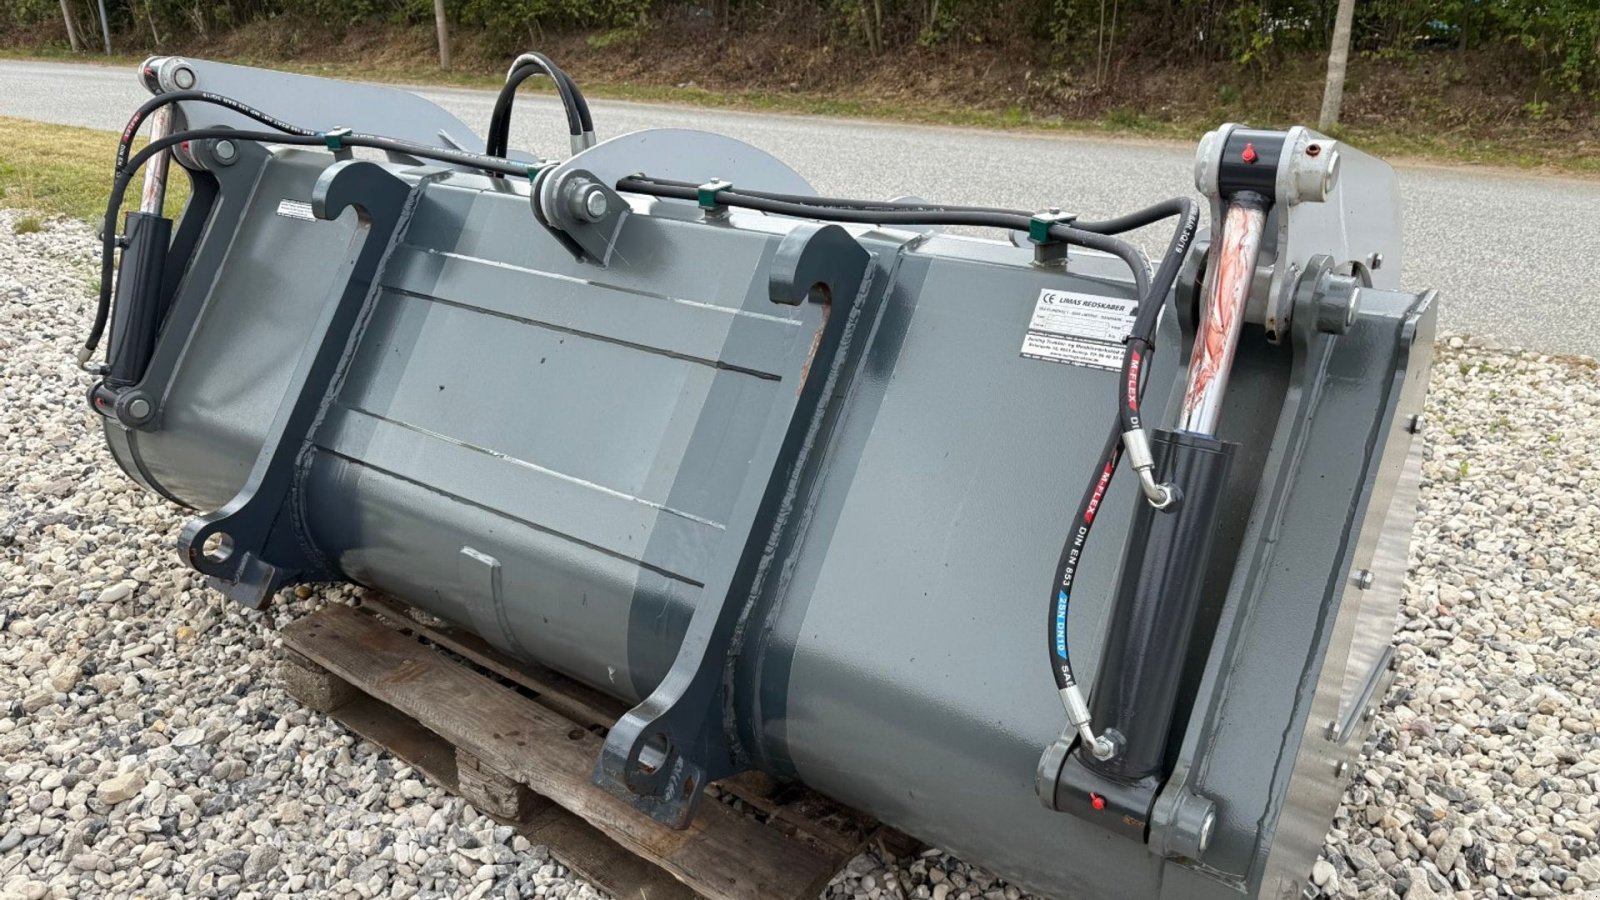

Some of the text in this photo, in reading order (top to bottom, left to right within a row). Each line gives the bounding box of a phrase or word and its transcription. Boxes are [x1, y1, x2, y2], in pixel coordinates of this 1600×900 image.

[1059, 297, 1126, 311] LIMAS REDSKABER
[1128, 360, 1140, 429] M-FLEX DI
[1086, 471, 1111, 515] M-FLEX
[1074, 526, 1087, 546] DIN
[1068, 548, 1079, 565] EN
[1063, 567, 1073, 586] 853
[1057, 622, 1066, 651] DN10
